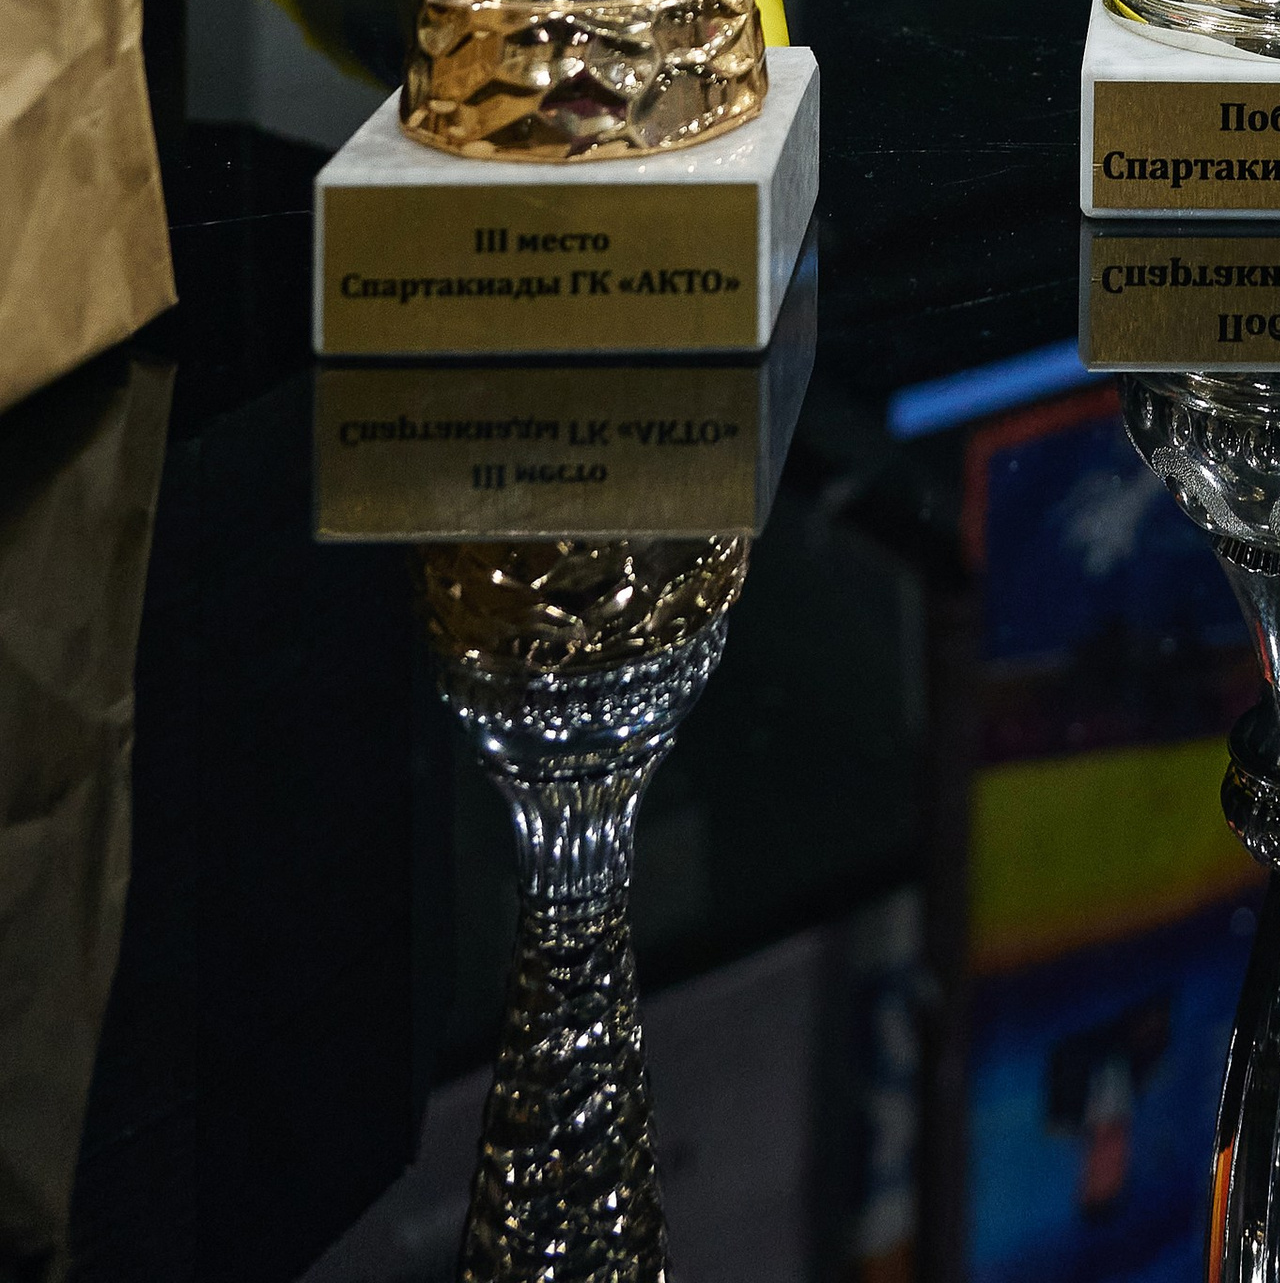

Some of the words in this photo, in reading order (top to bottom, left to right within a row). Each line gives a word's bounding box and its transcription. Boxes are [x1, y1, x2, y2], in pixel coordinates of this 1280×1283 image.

[475, 228, 508, 254] III
[517, 232, 610, 253] место
[340, 272, 561, 305] Спартакиады
[570, 270, 611, 296] ГК
[618, 269, 740, 295] «АКТО»
